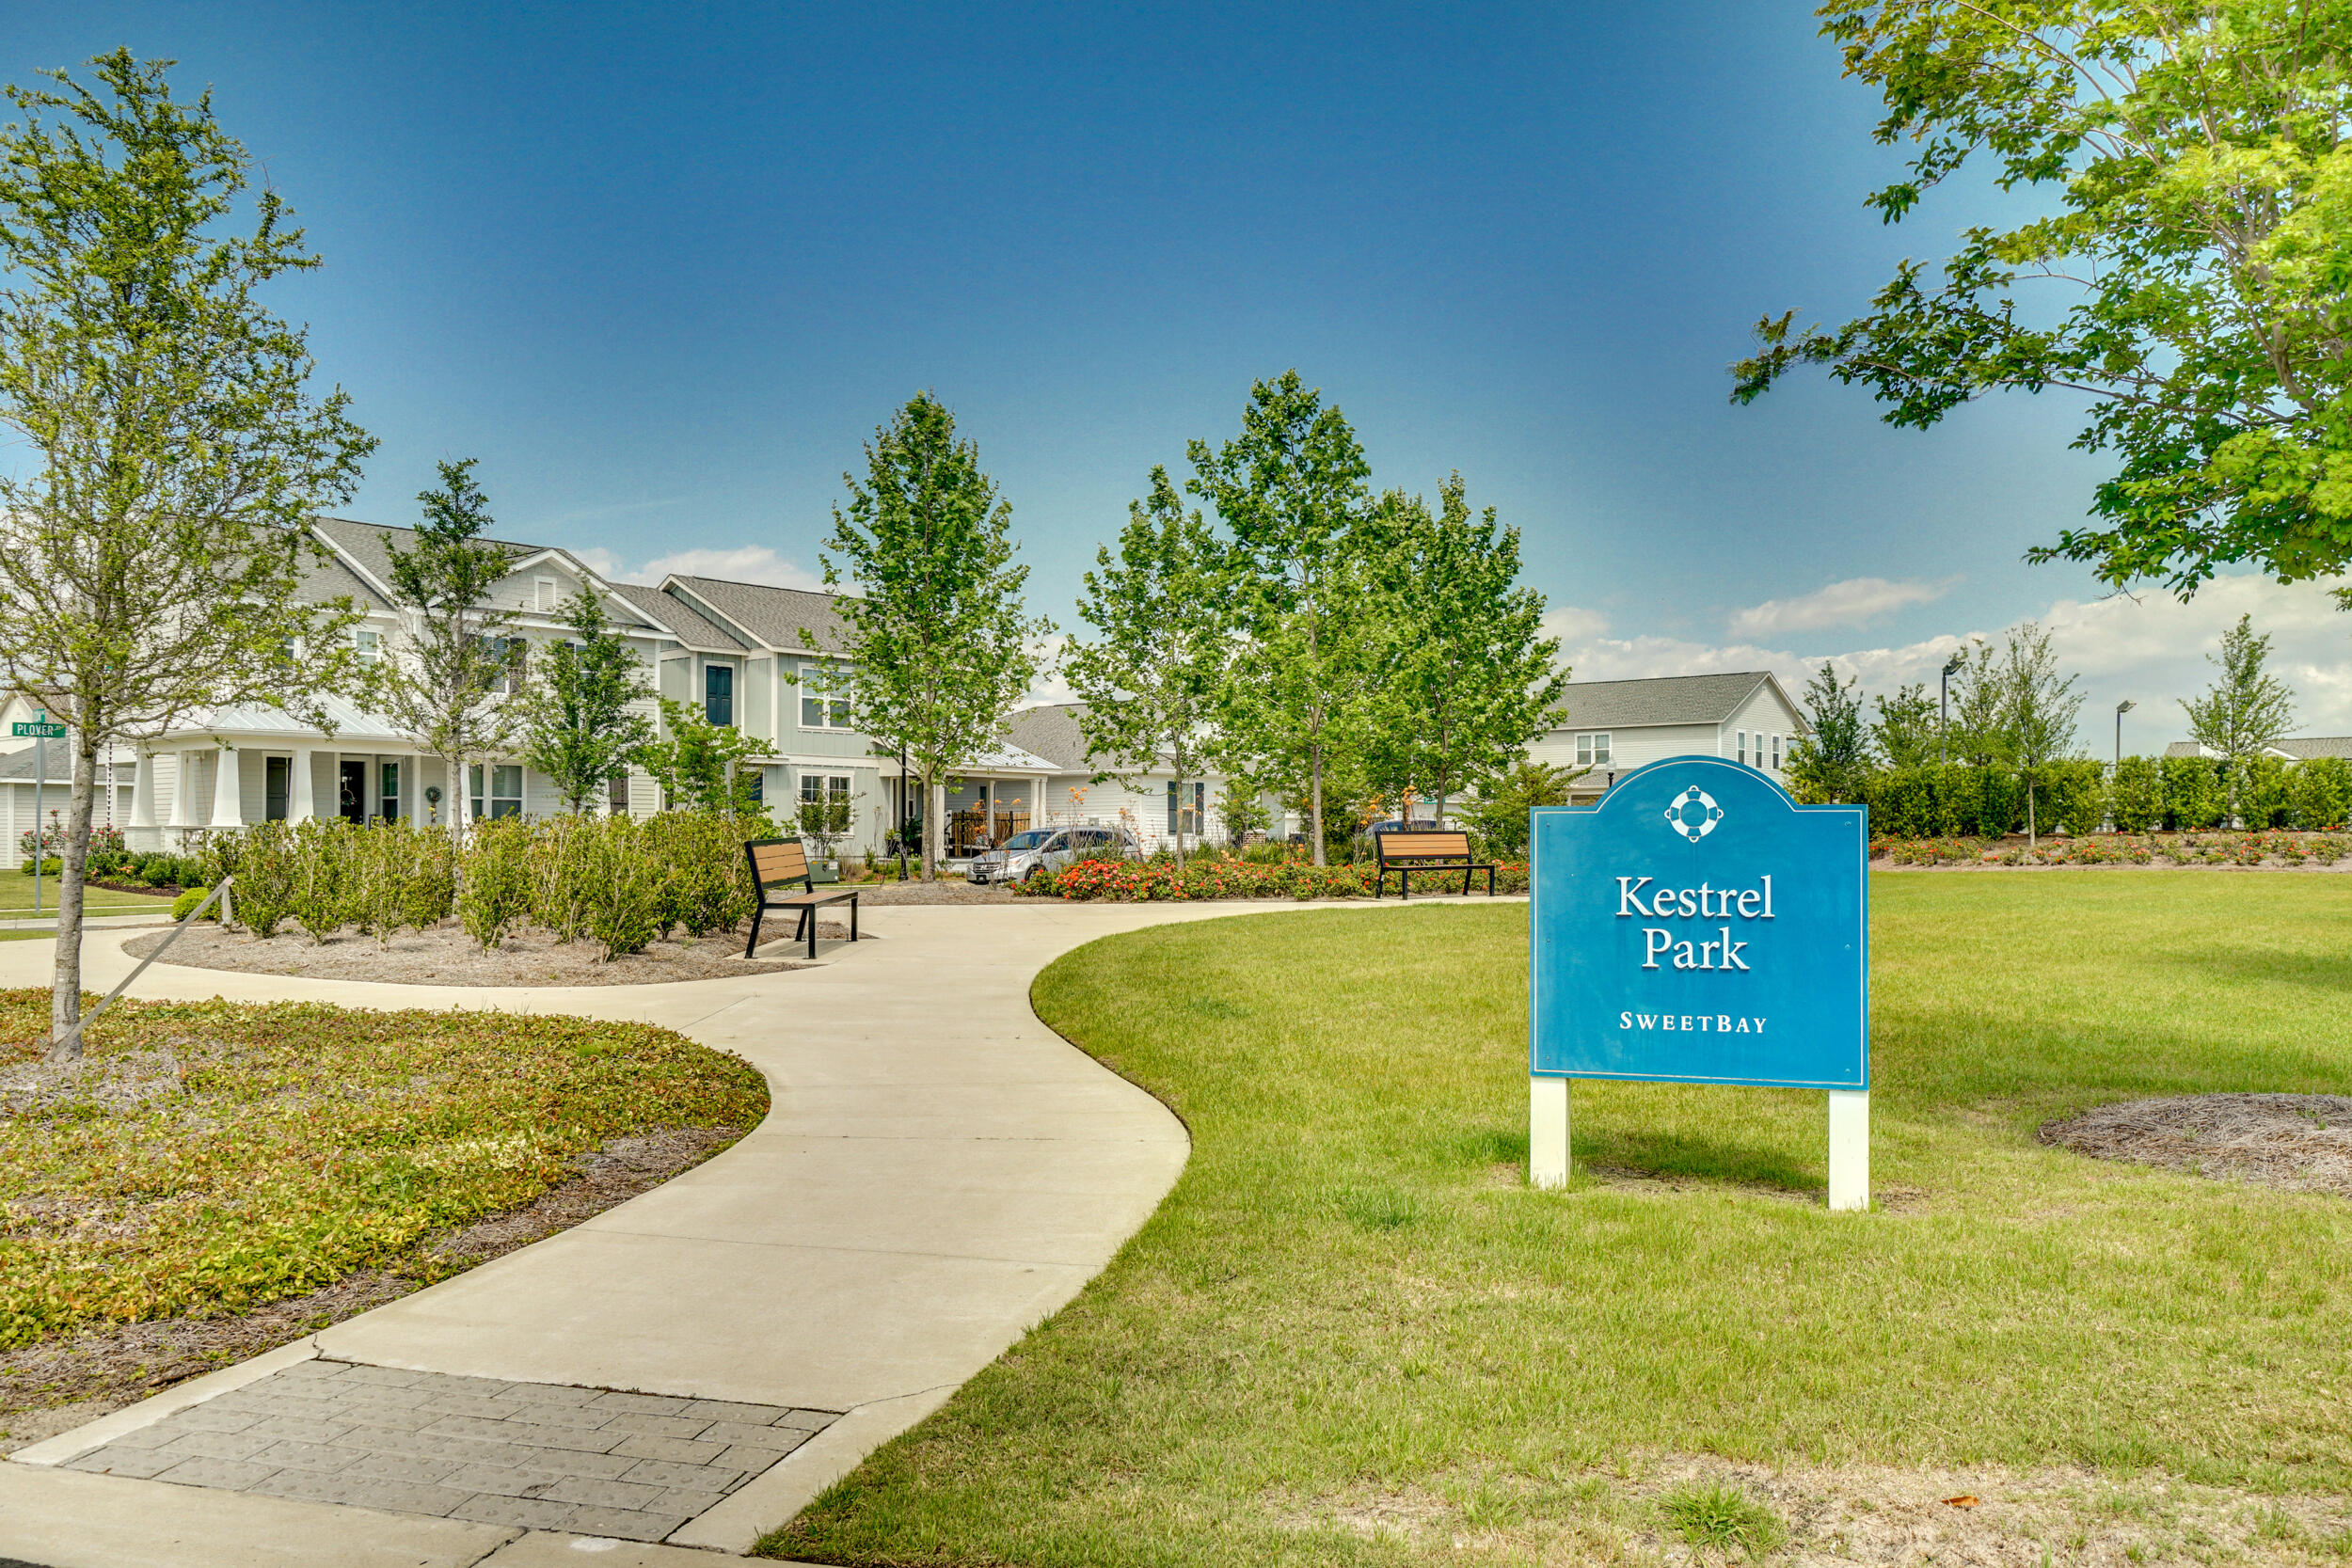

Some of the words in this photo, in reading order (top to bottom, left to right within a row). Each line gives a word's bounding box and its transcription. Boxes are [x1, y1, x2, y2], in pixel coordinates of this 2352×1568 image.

[17, 724, 54, 736] PLOVER
[1615, 875, 1775, 918] Kestrel
[1642, 927, 1751, 971] Park
